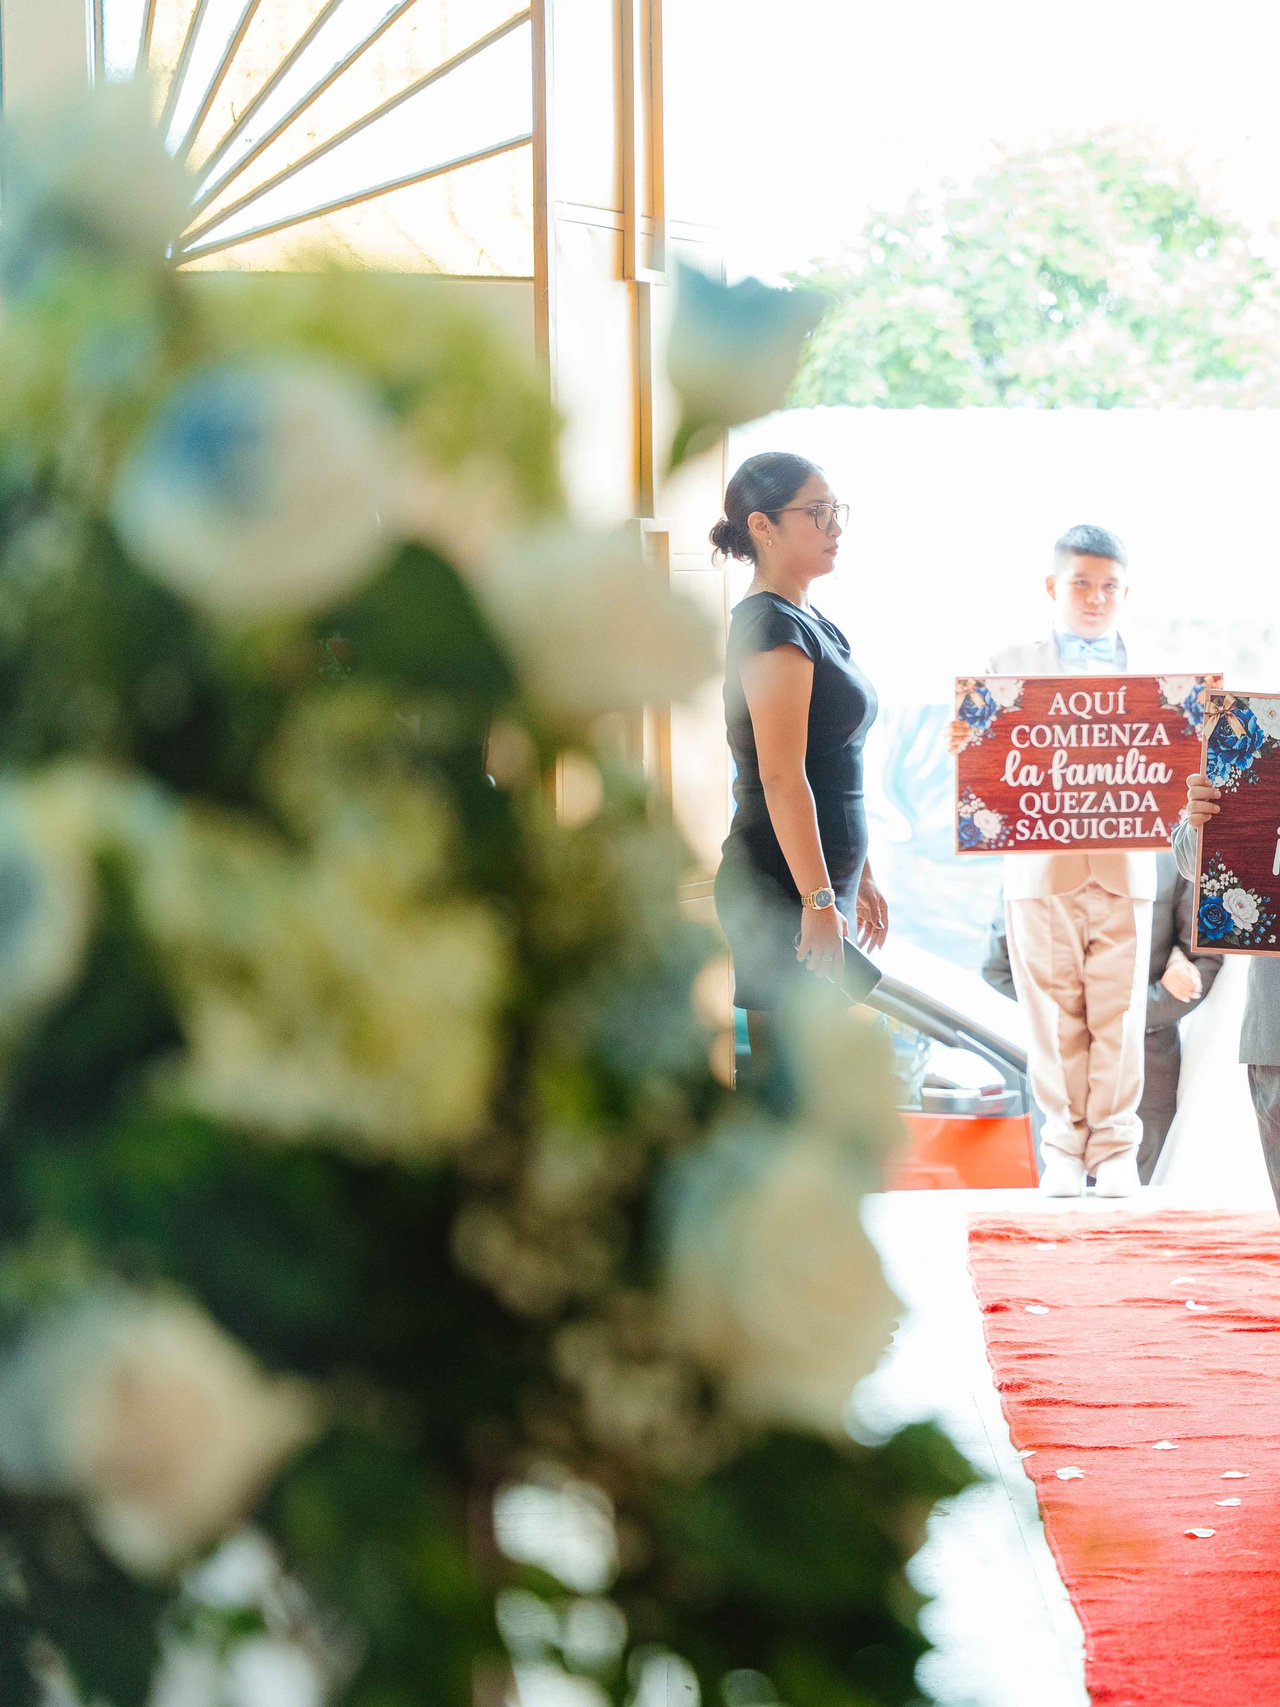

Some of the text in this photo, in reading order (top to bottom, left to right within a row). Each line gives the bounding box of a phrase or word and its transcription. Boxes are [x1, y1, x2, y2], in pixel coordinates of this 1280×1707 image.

[1048, 685, 1127, 719] AQUÍ
[1010, 722, 1171, 748] COMIENZA
[1000, 747, 1173, 791] la familia
[1018, 790, 1160, 819] QUEZADA
[1015, 816, 1168, 844] SAQUICELA
